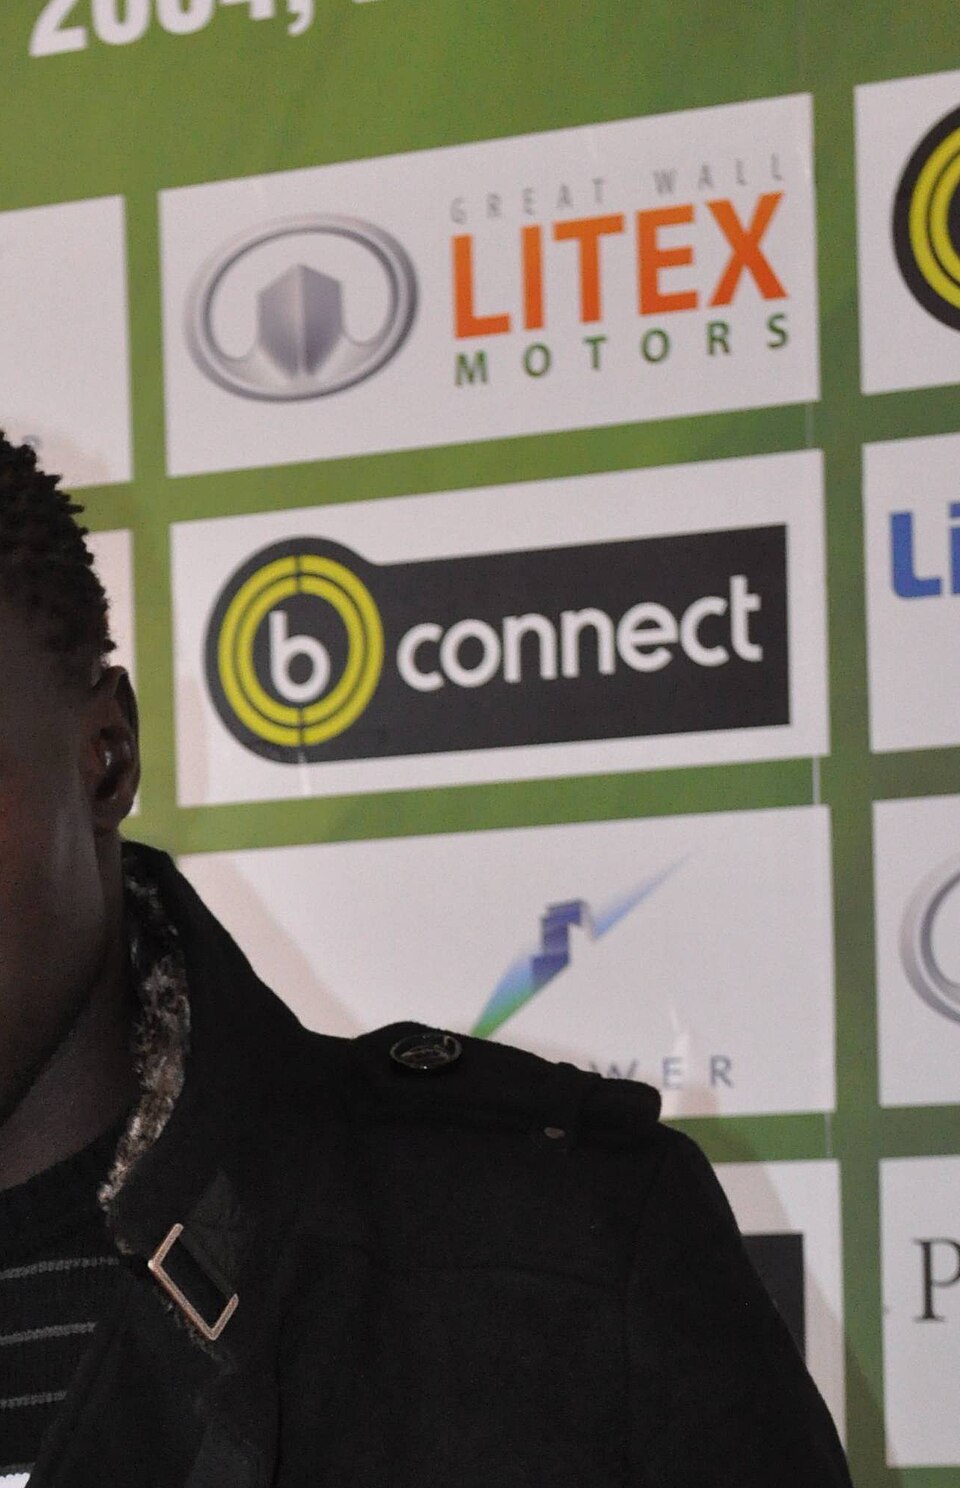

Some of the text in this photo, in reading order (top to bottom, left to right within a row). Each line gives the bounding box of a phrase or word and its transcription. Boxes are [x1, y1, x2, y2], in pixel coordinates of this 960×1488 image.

[450, 153, 783, 225] GREAT WALL
[451, 190, 788, 340] LITEX
[454, 313, 790, 387] MOTORS
[396, 575, 764, 692] connect
